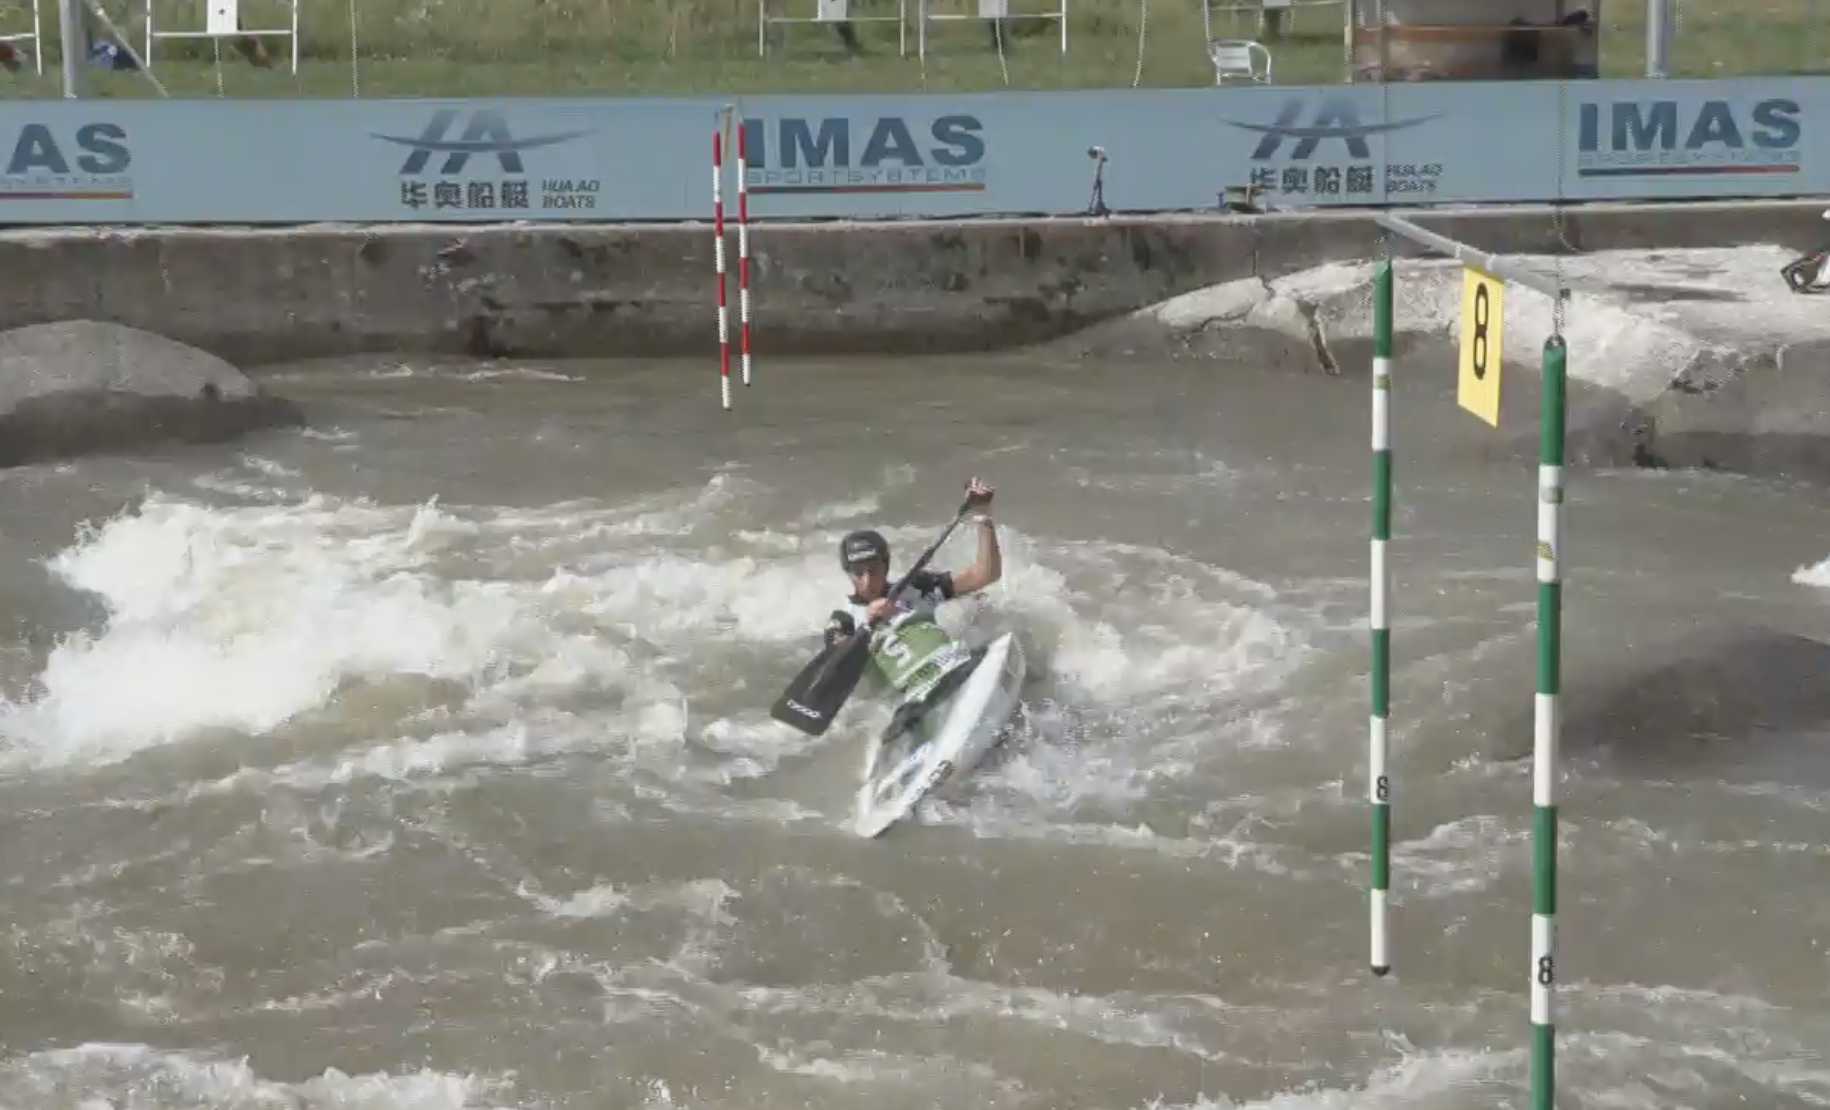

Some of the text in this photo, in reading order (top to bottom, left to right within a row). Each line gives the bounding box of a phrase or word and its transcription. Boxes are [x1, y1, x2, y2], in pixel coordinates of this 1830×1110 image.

[745, 114, 985, 168] IMAS
[1579, 99, 1801, 151] IMAS
[401, 180, 529, 208] 华奥船艇
[1473, 282, 1489, 380] 8
[1538, 956, 1554, 986] 8
